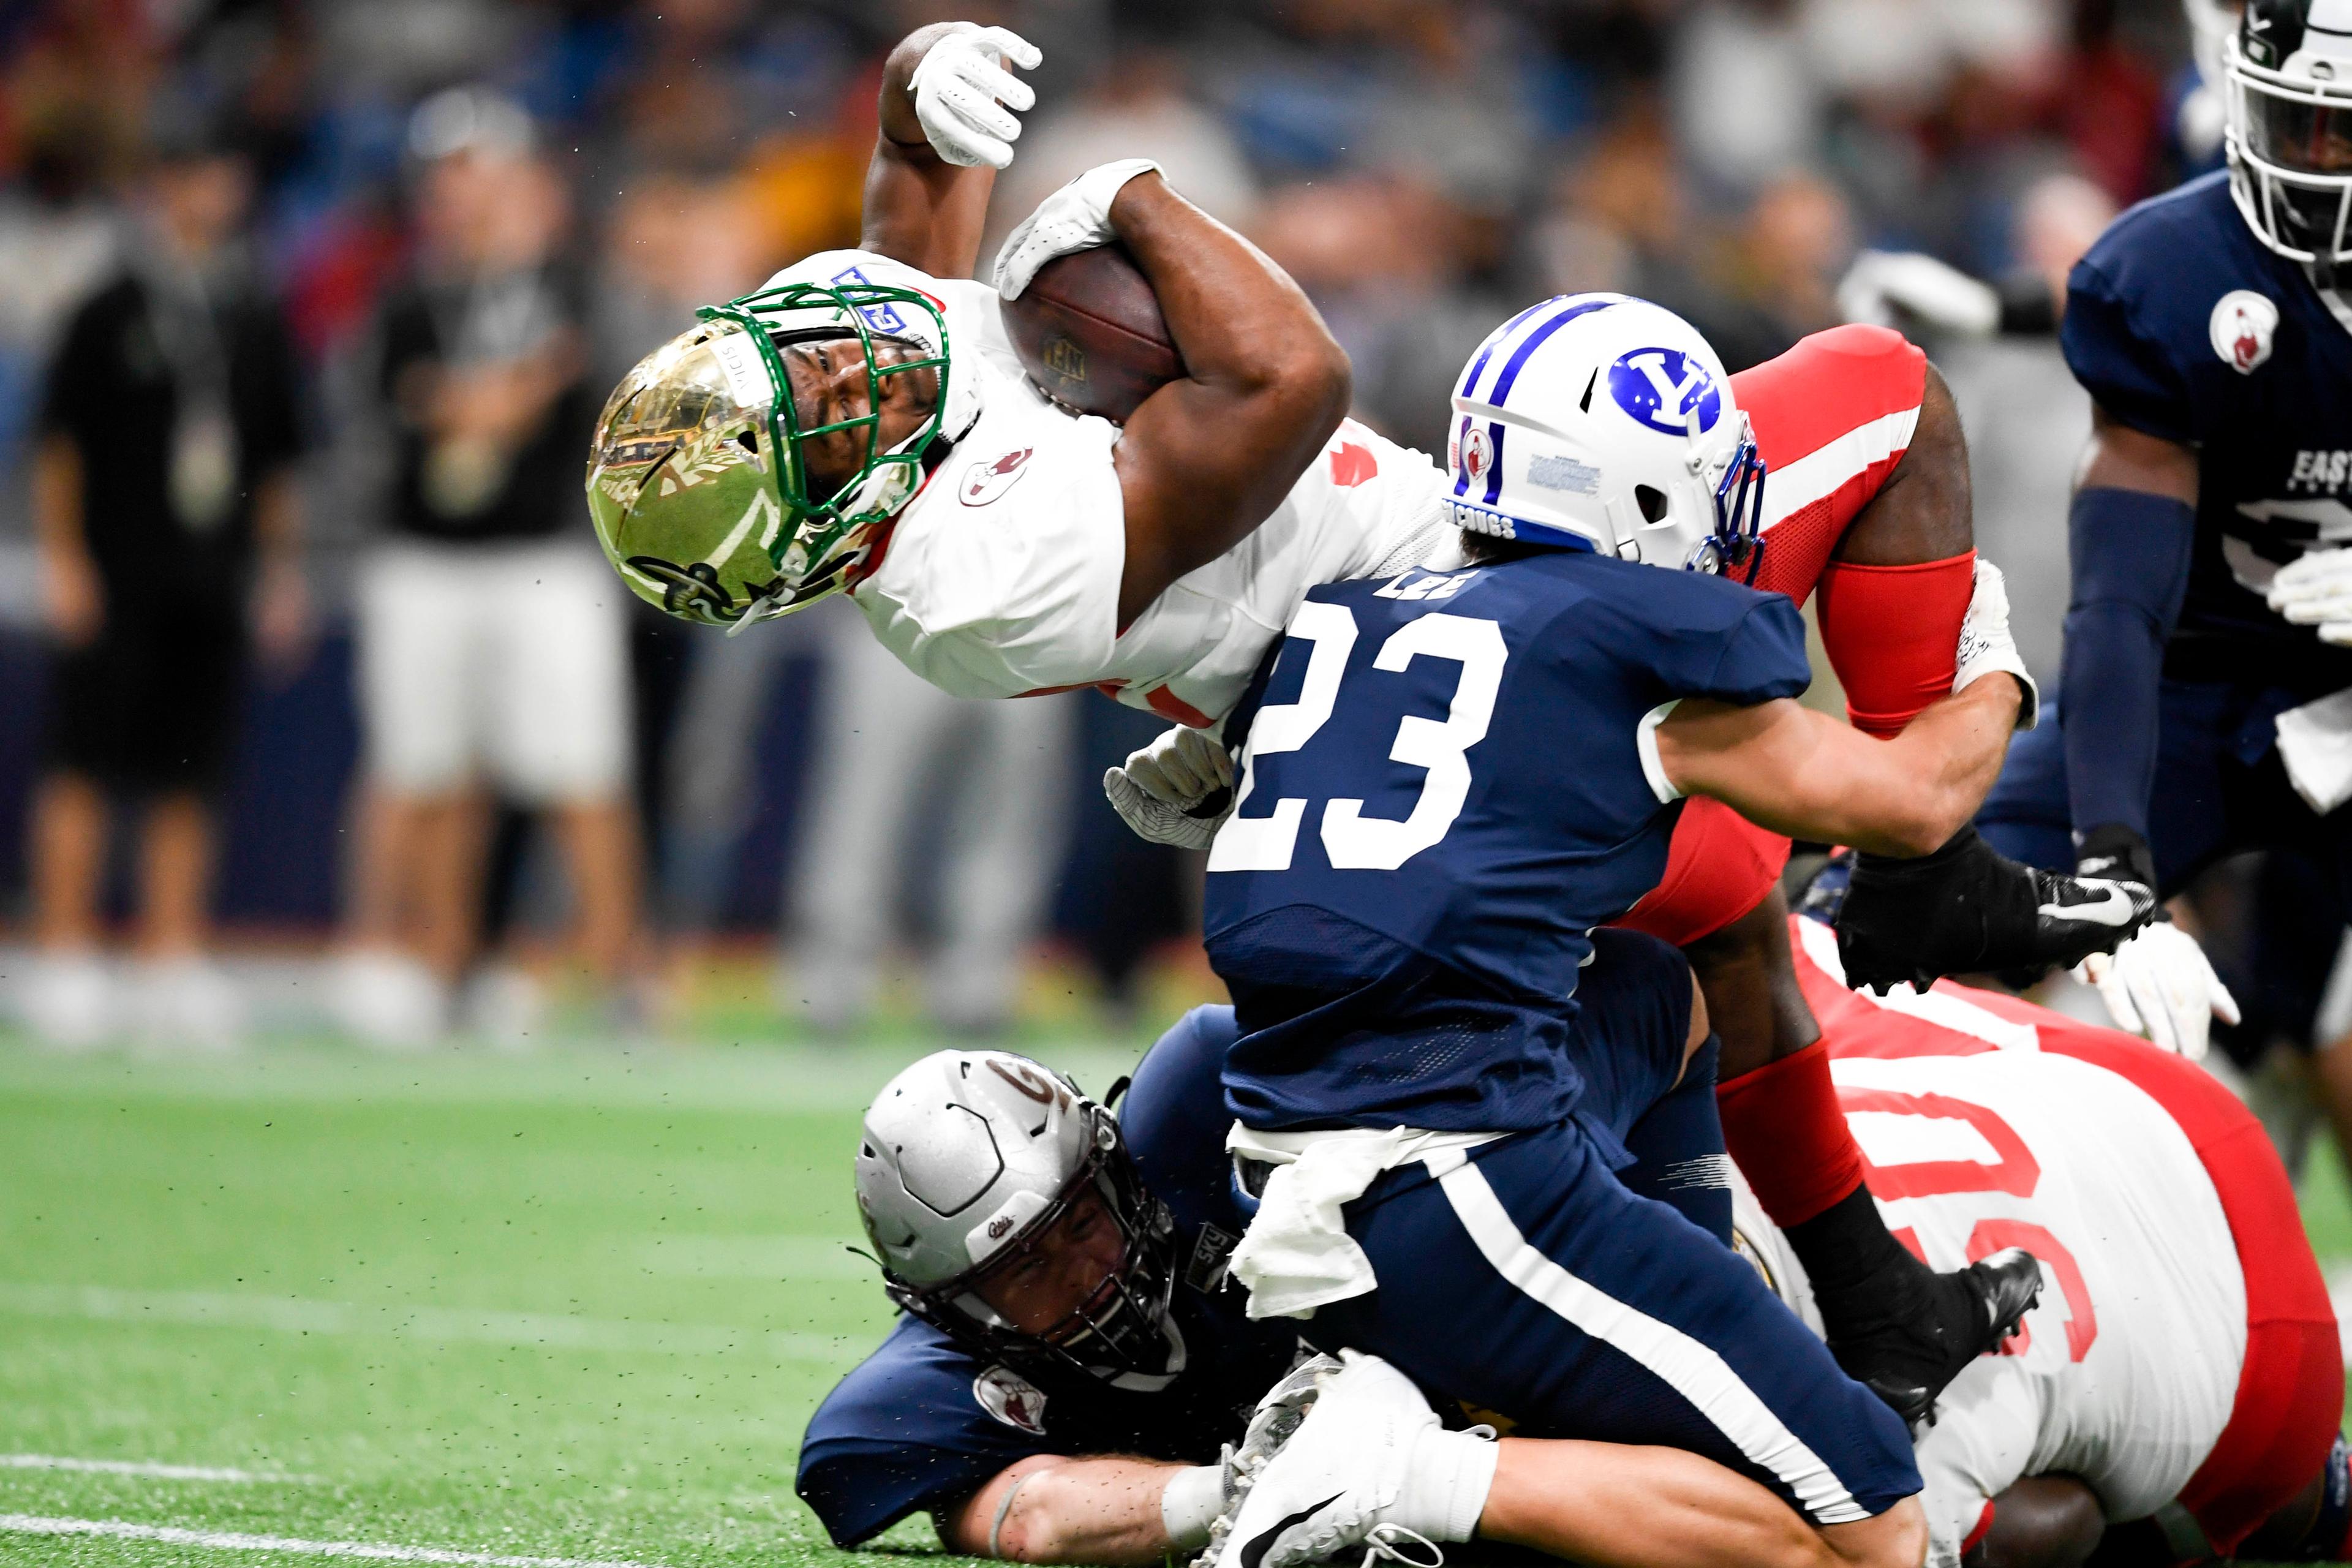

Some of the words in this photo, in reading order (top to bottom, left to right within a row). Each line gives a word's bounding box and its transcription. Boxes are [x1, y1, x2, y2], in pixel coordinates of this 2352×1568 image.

[1627, 352, 1708, 428] Y
[2293, 449, 2352, 483] EAS
[1371, 569, 1481, 601] LEE
[1206, 600, 1509, 873] 23
[1197, 1227, 1229, 1264] SKY
